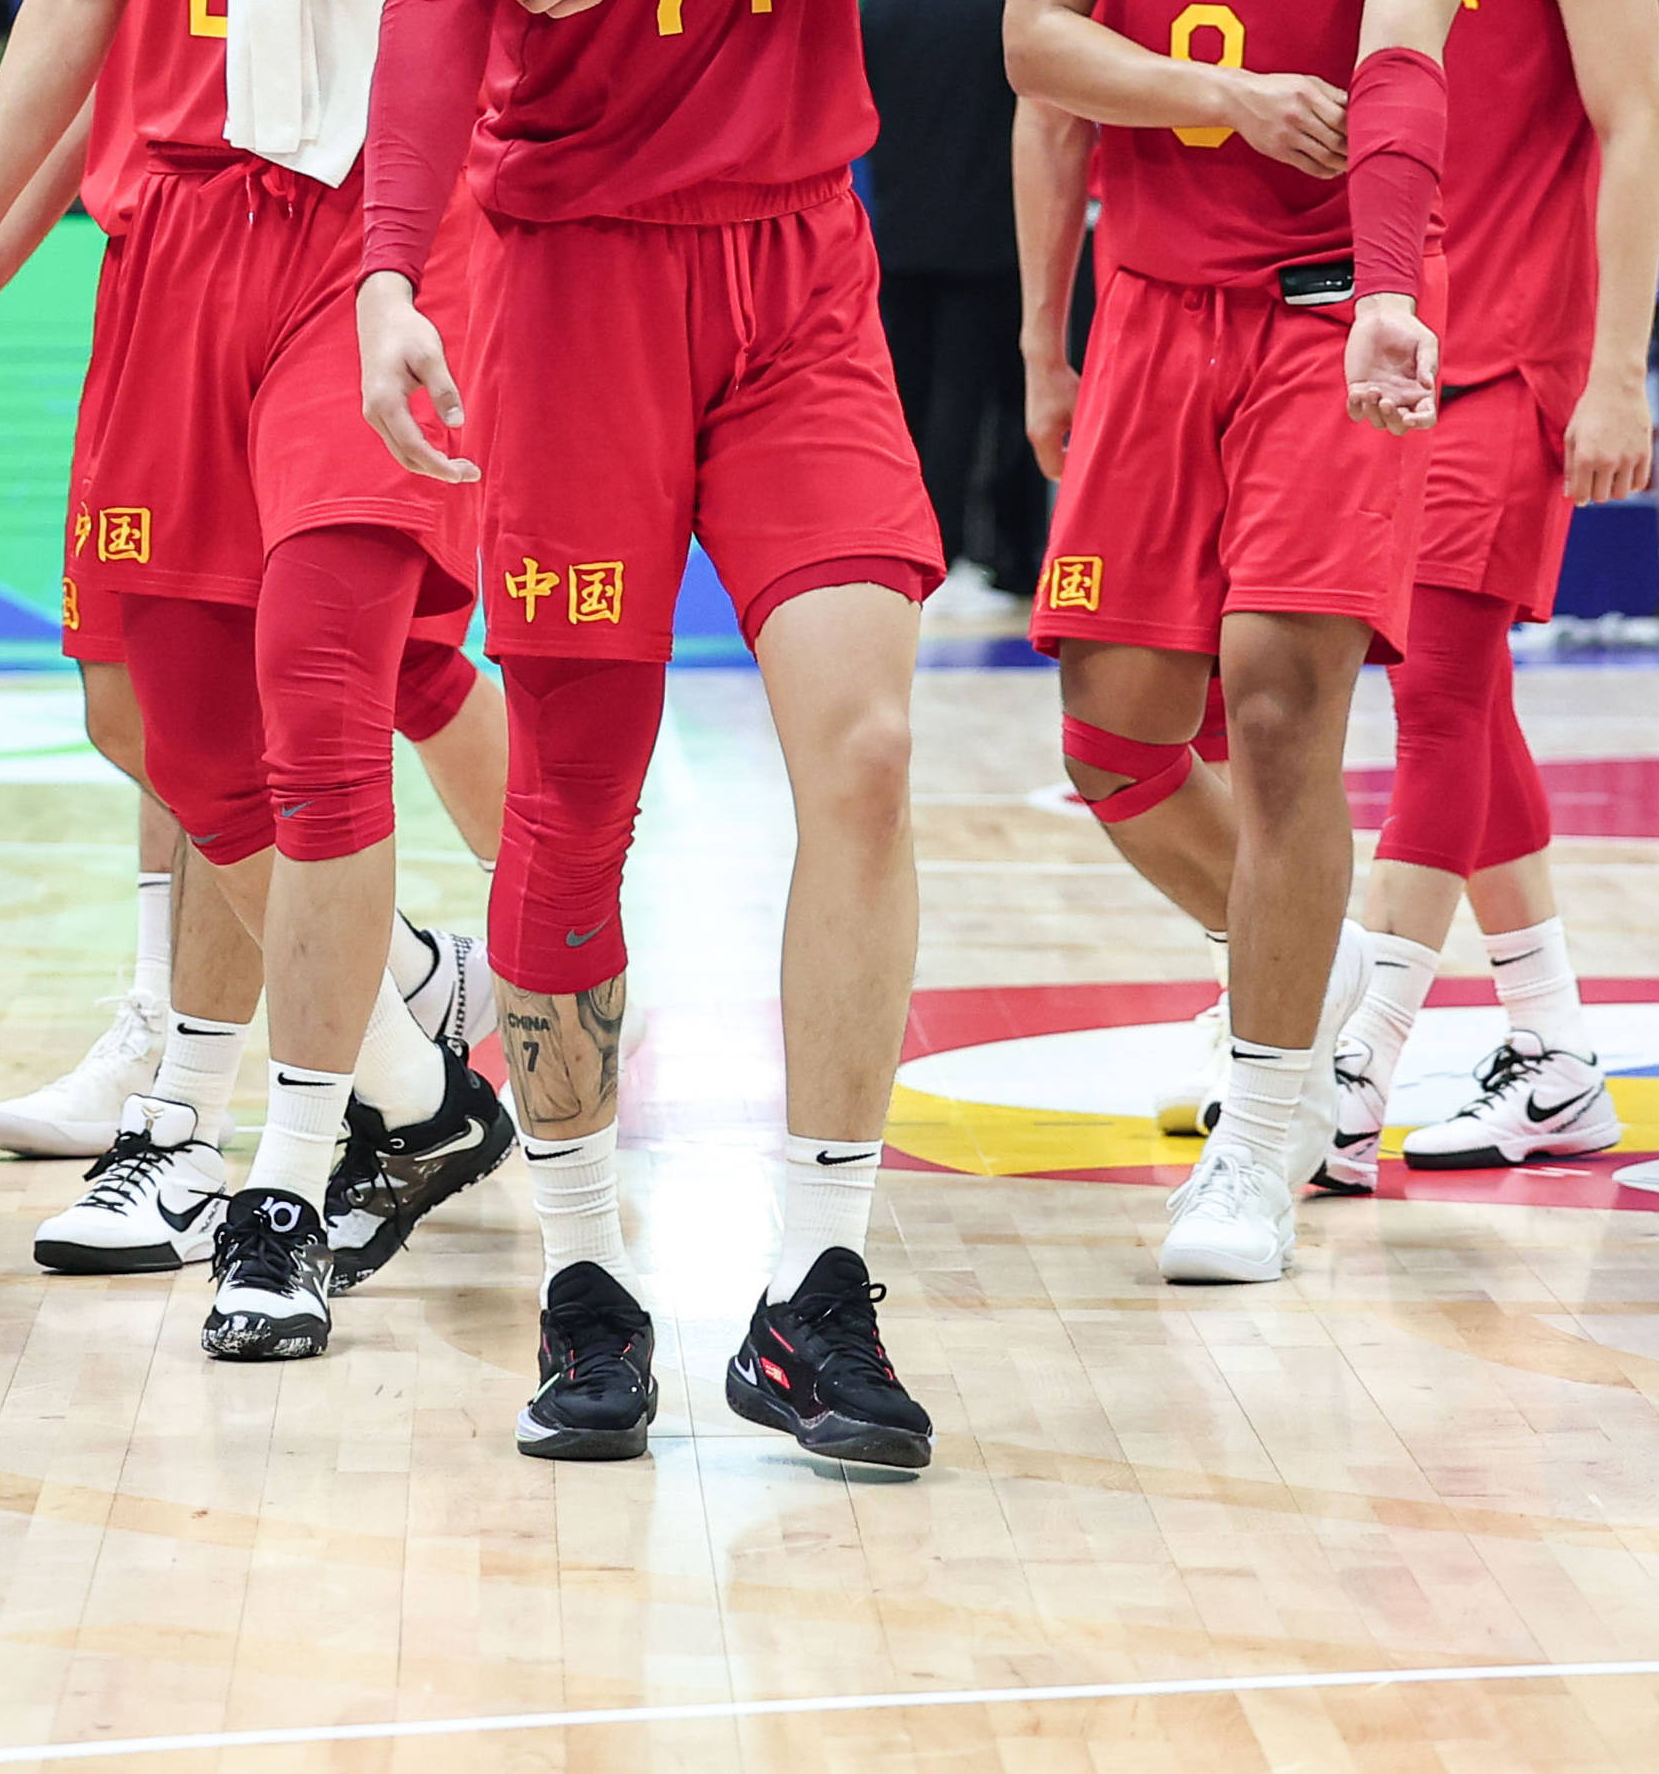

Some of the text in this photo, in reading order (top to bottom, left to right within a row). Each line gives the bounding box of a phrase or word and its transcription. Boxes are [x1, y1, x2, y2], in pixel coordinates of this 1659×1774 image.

[504, 556, 625, 625] 中国
[507, 1012, 551, 1032] CHINA
[522, 1041, 540, 1073] 7
